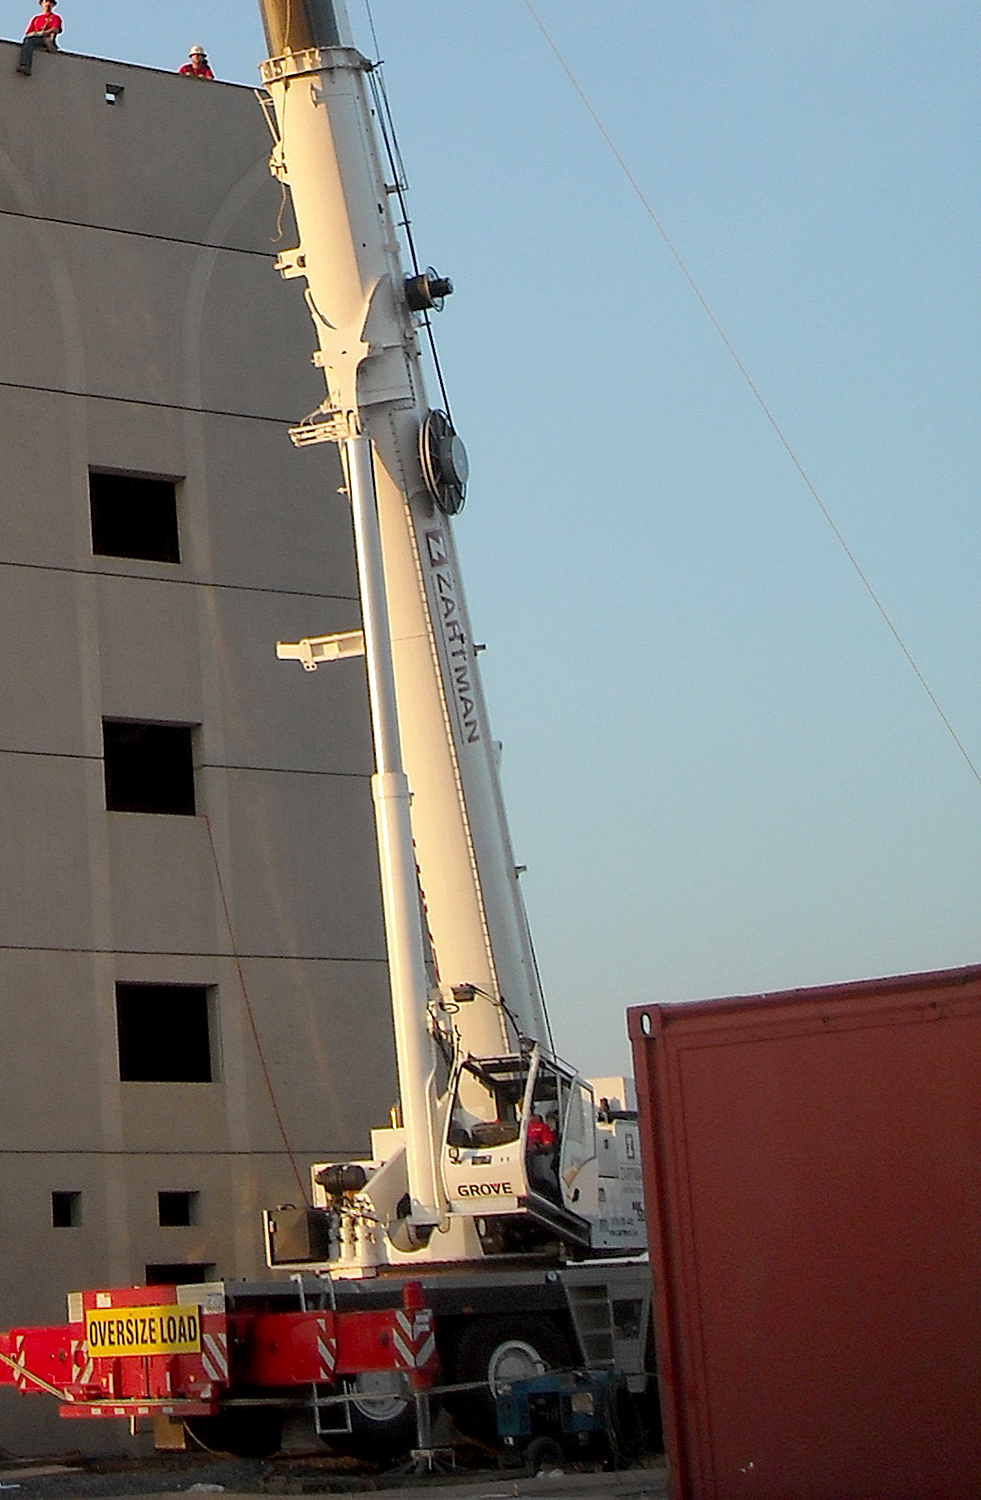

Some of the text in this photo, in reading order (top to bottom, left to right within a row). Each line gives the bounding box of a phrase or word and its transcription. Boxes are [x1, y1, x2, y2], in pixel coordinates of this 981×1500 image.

[435, 572, 480, 743] ZARTMAN
[457, 1182, 513, 1197] GROVE
[89, 1315, 197, 1347] OVERSIZE LOAD
